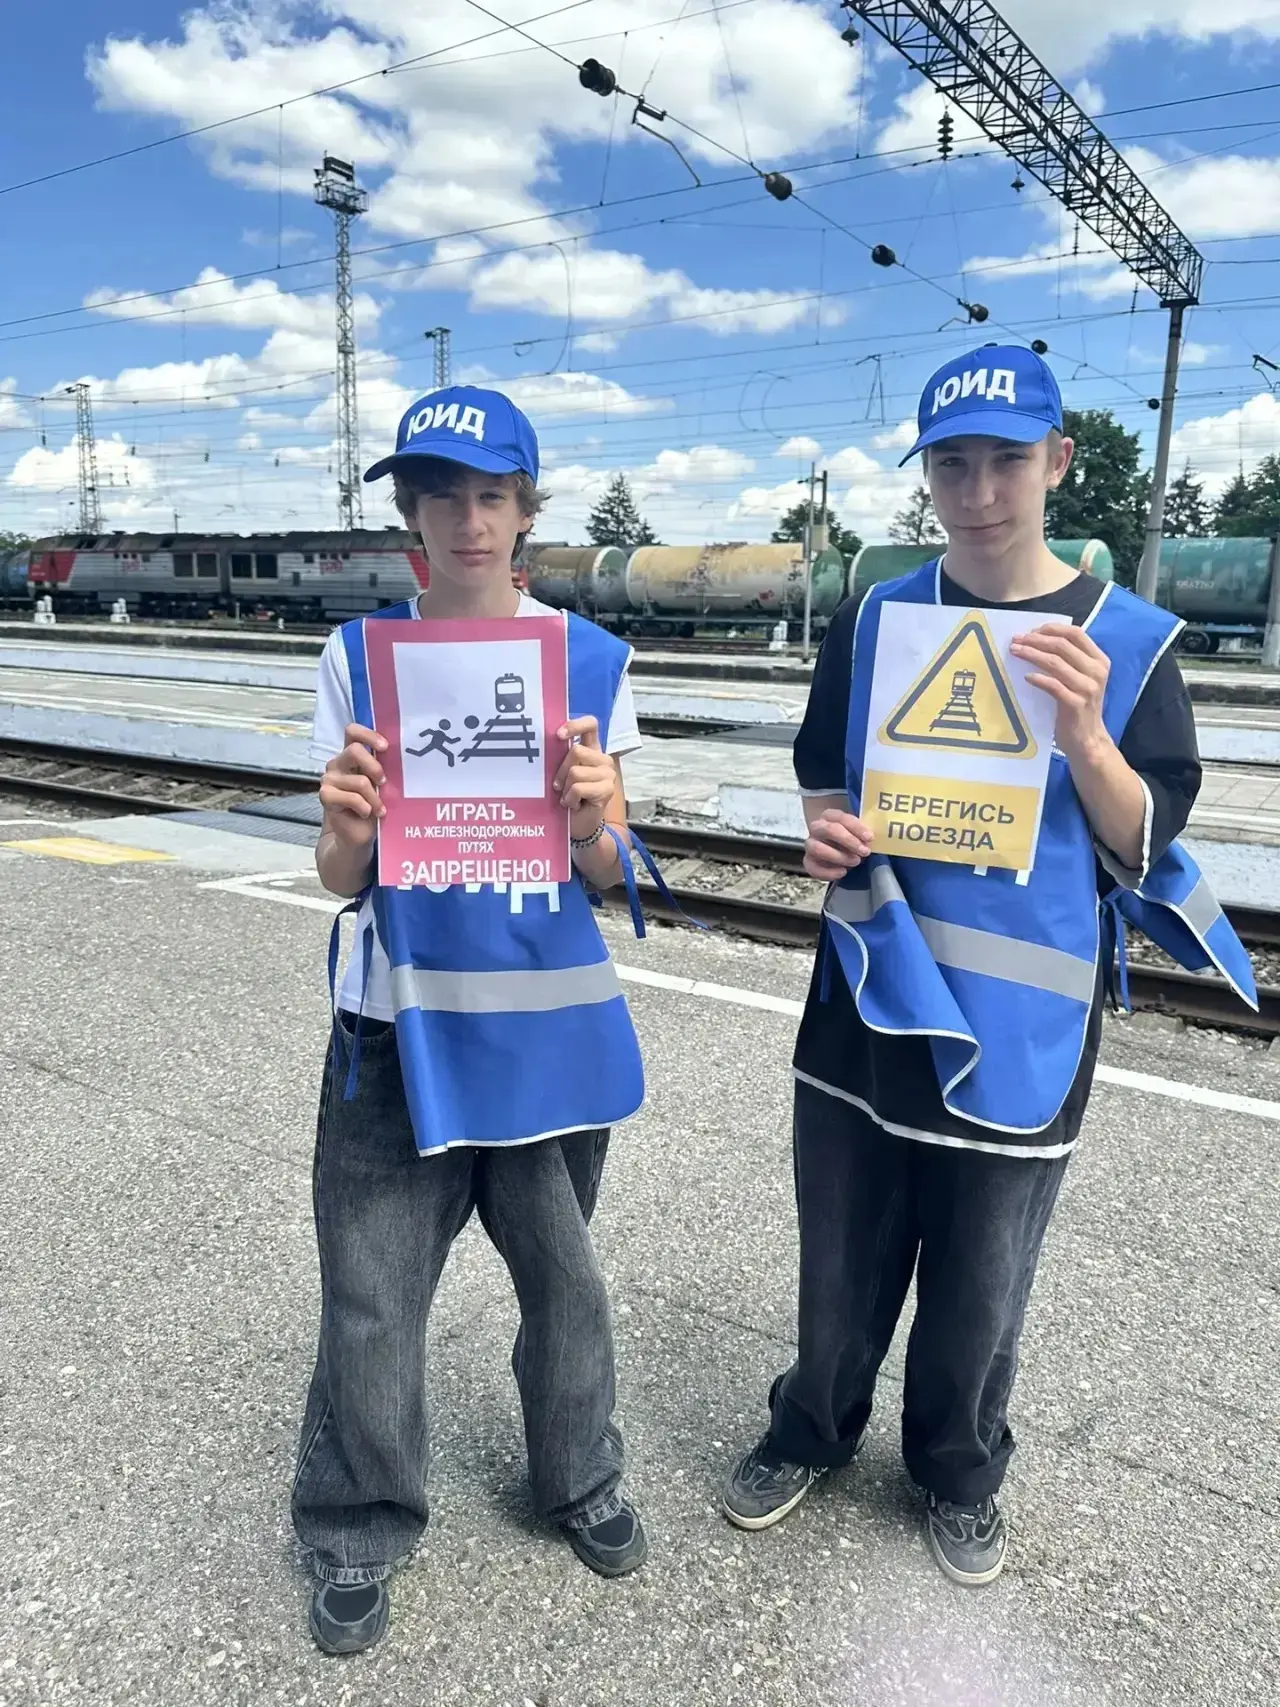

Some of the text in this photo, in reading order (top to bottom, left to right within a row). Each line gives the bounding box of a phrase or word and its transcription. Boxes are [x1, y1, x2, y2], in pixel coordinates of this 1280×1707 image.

[931, 368, 1016, 415] ЮИД
[406, 403, 486, 442] ЮИД
[436, 803, 516, 821] ИГРАТЬ
[878, 791, 1015, 825] БЕРЕГИСЬ
[405, 825, 545, 839] НА ЖЕЛЕЗНОДОРОЖНЫХ
[887, 821, 995, 851] ПОЕЗДА
[458, 841, 495, 854] ПУТЯХ
[400, 859, 551, 884] ЗАПРЕЩЕНО!
